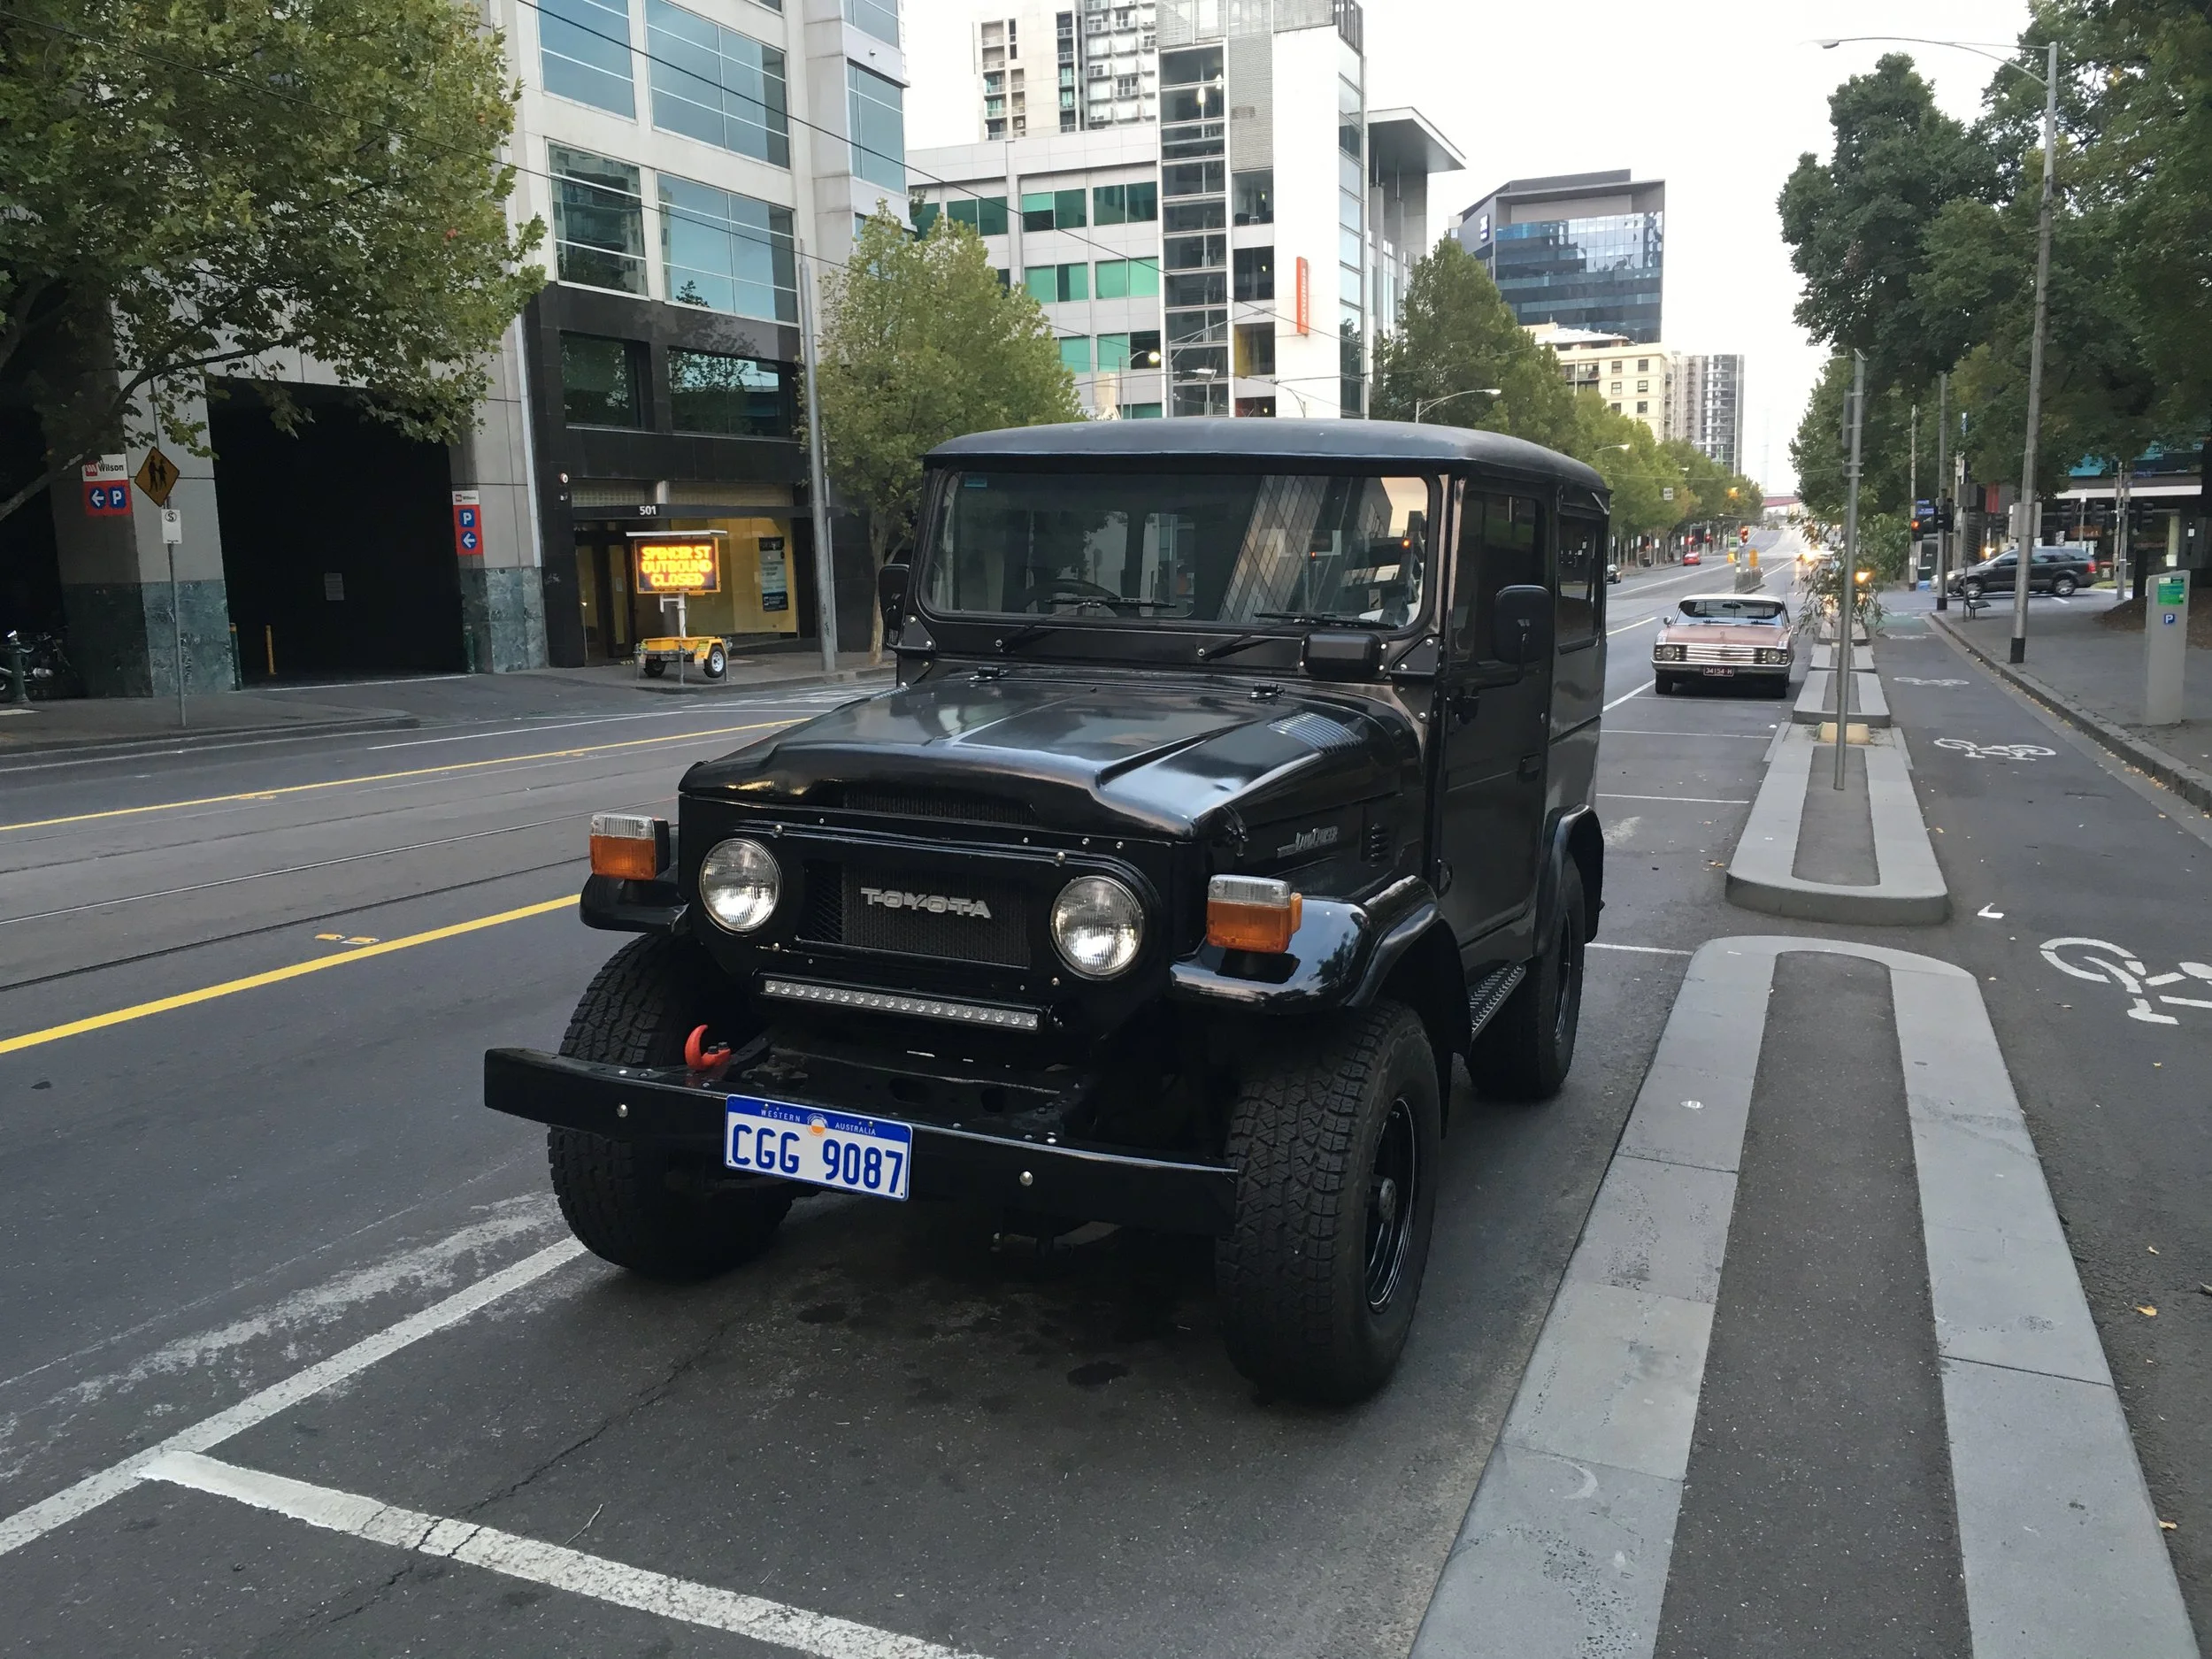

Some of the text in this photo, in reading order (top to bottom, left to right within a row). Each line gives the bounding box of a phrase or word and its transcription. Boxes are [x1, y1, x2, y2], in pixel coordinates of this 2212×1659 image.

[98, 462, 124, 472] Wilson
[112, 490, 122, 504] P
[640, 505, 657, 515] 501
[463, 512, 472, 525] P
[641, 545, 712, 560] SPENCER ST
[641, 560, 712, 573] OUTBOUND
[650, 572, 705, 587] CLOSED
[2165, 614, 2174, 624] P
[860, 887, 992, 919] TOYOTA
[760, 1109, 876, 1136] WESTERN AUSTRALIA
[732, 1124, 903, 1194] CGG 9087
